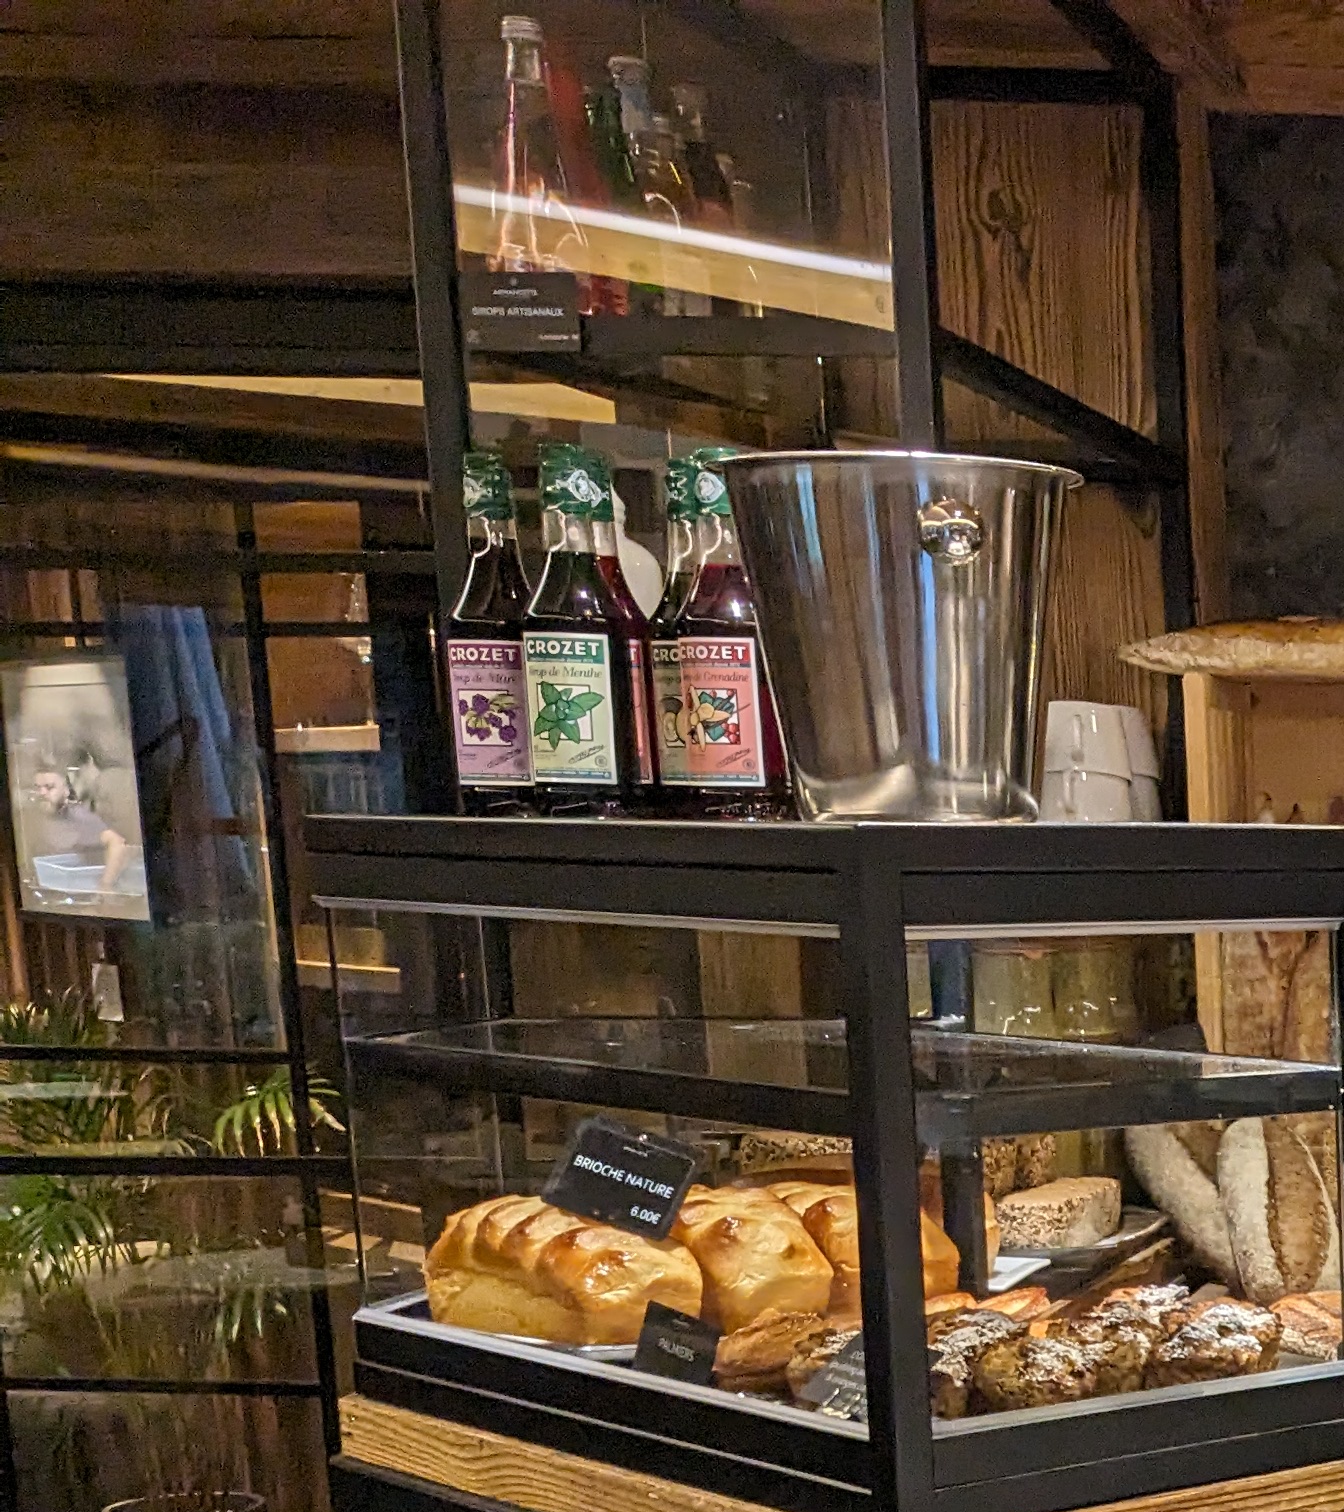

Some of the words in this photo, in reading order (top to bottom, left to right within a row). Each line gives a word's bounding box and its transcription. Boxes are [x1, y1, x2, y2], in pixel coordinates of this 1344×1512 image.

[450, 647, 517, 662] CROZET
[527, 639, 600, 656] CROZET
[680, 646, 746, 660] CROZET
[563, 666, 602, 678] Menthe
[703, 672, 748, 682] Grenadine
[573, 1154, 627, 1183] BRIOCHE
[624, 1172, 675, 1200] NATURE
[629, 1204, 662, 1226] 6.00€
